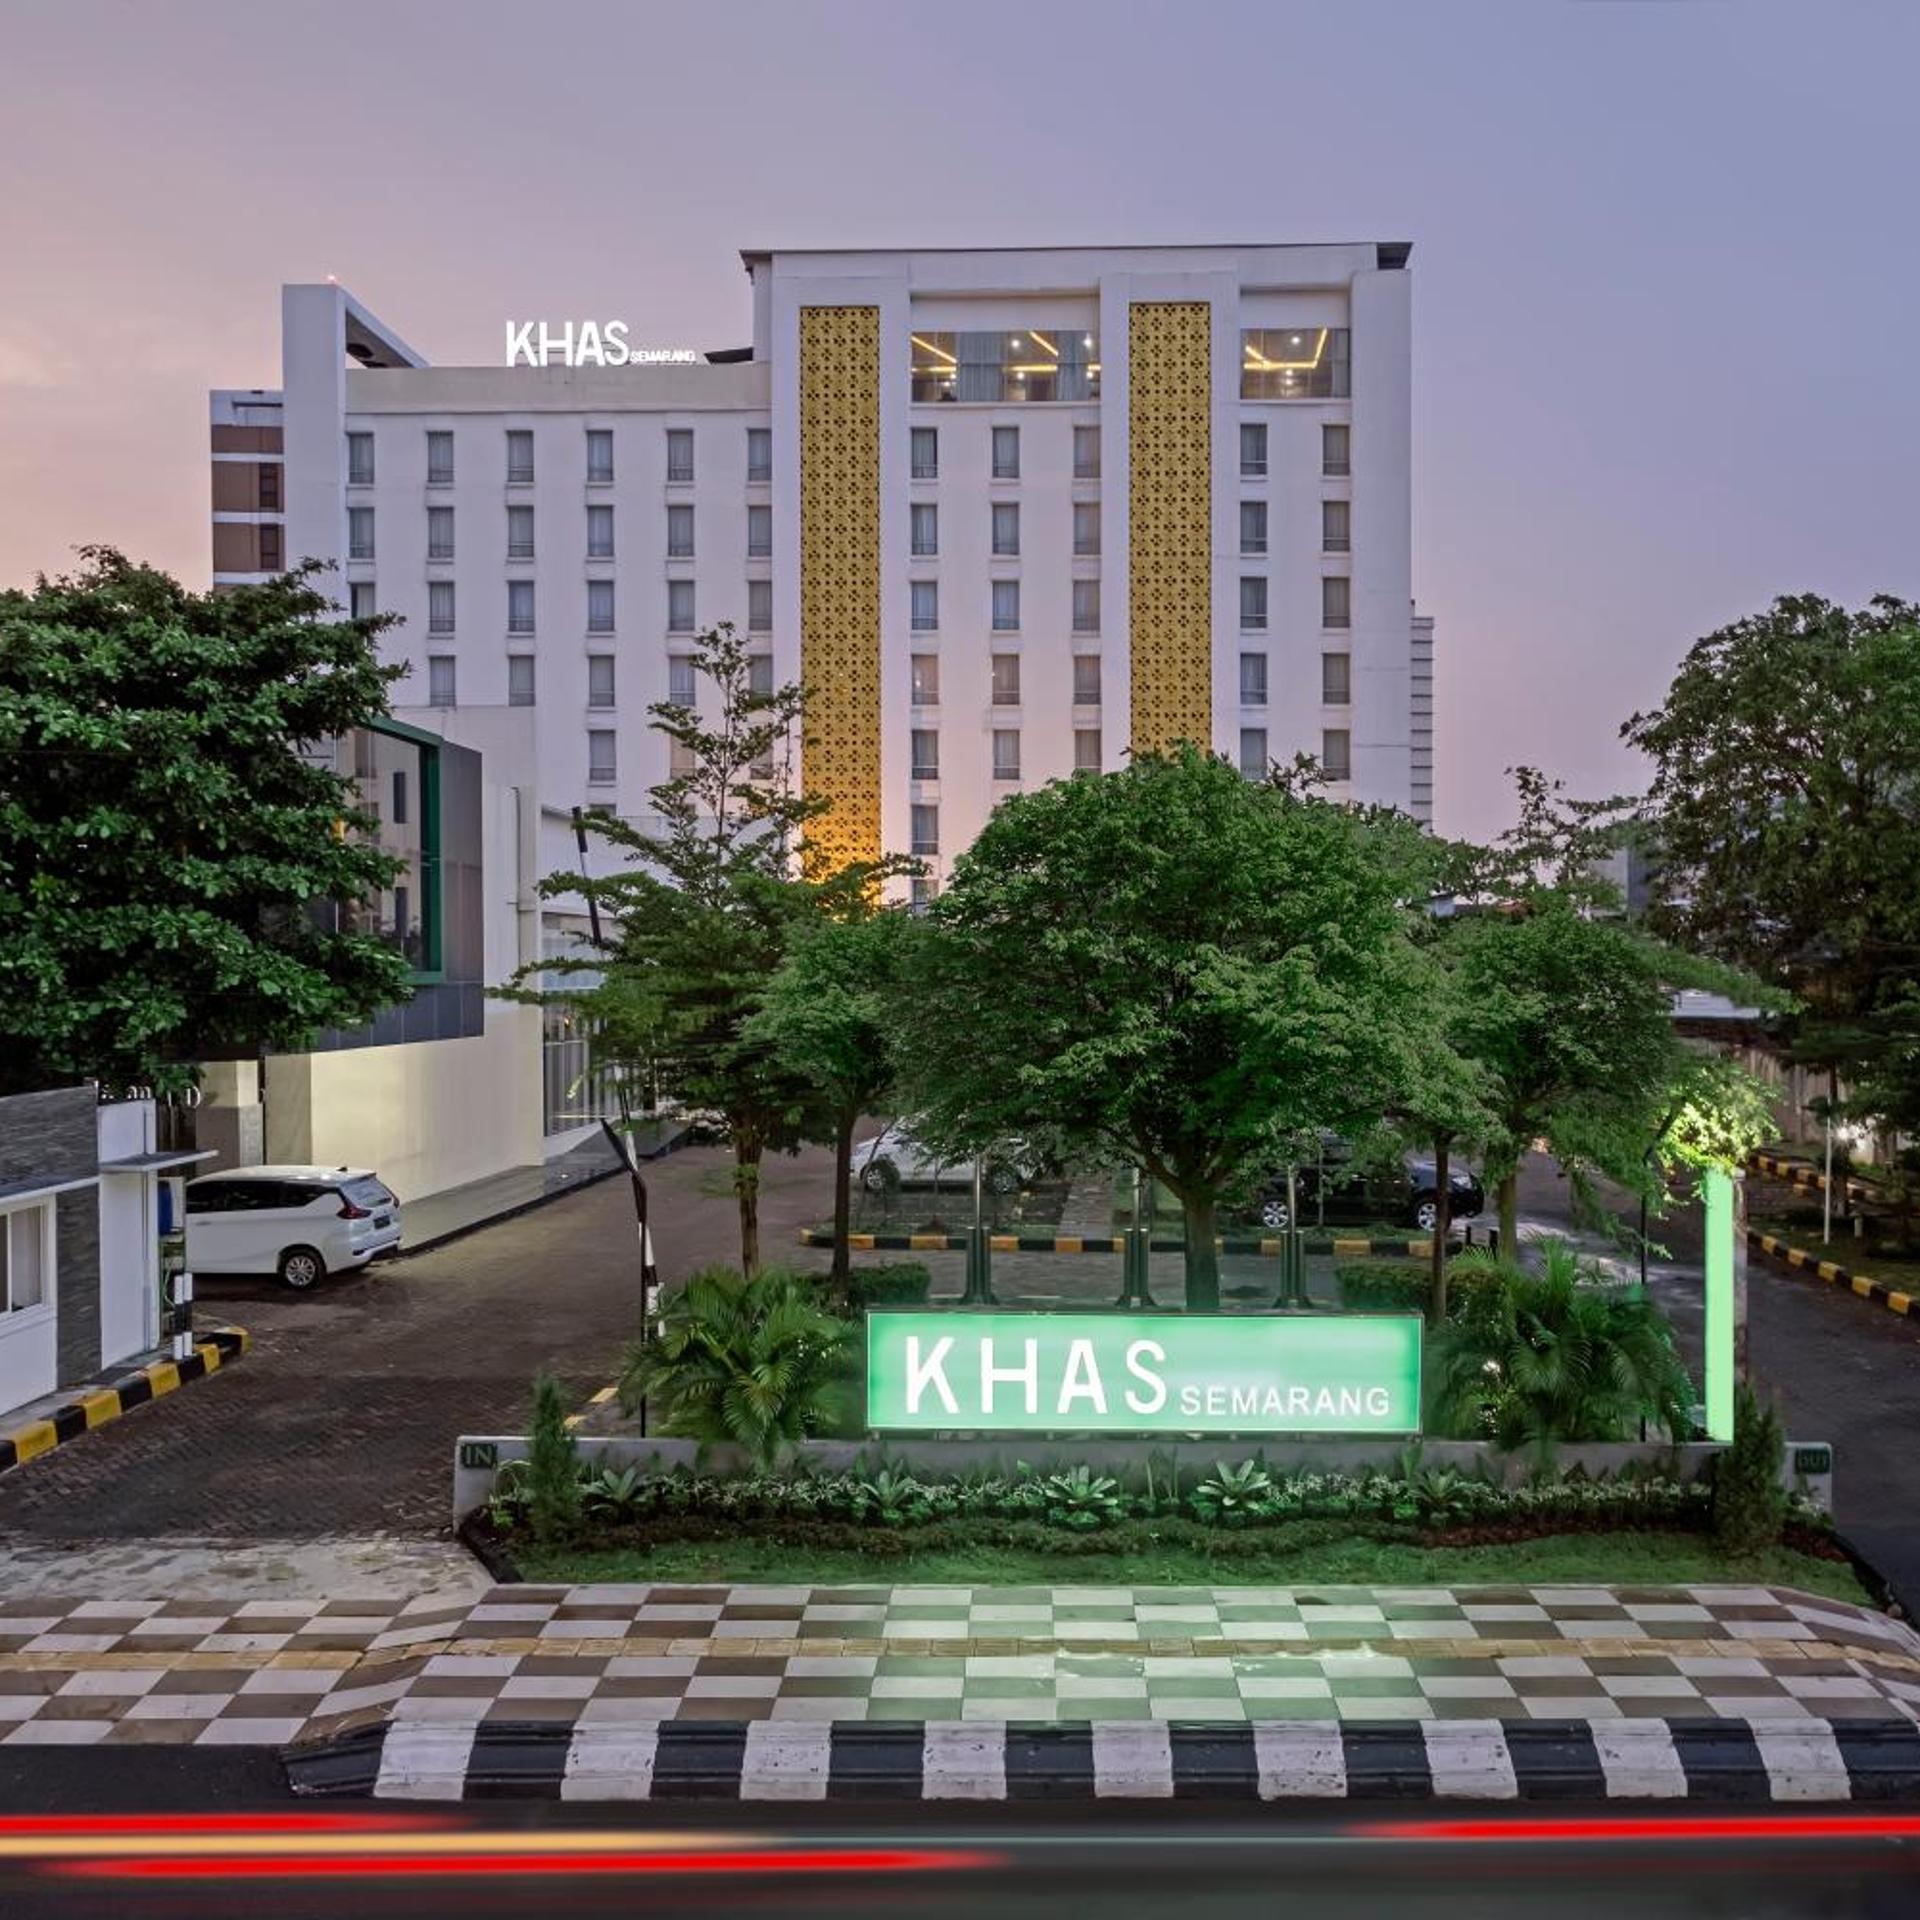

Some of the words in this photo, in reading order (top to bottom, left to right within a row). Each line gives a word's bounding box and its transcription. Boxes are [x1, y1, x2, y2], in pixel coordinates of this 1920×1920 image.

[506, 320, 629, 367] KHAS
[630, 350, 696, 363] SEMARANG
[905, 1335, 1168, 1415] KHAS
[1180, 1385, 1391, 1418] SEMARANG
[466, 1445, 493, 1465] IN
